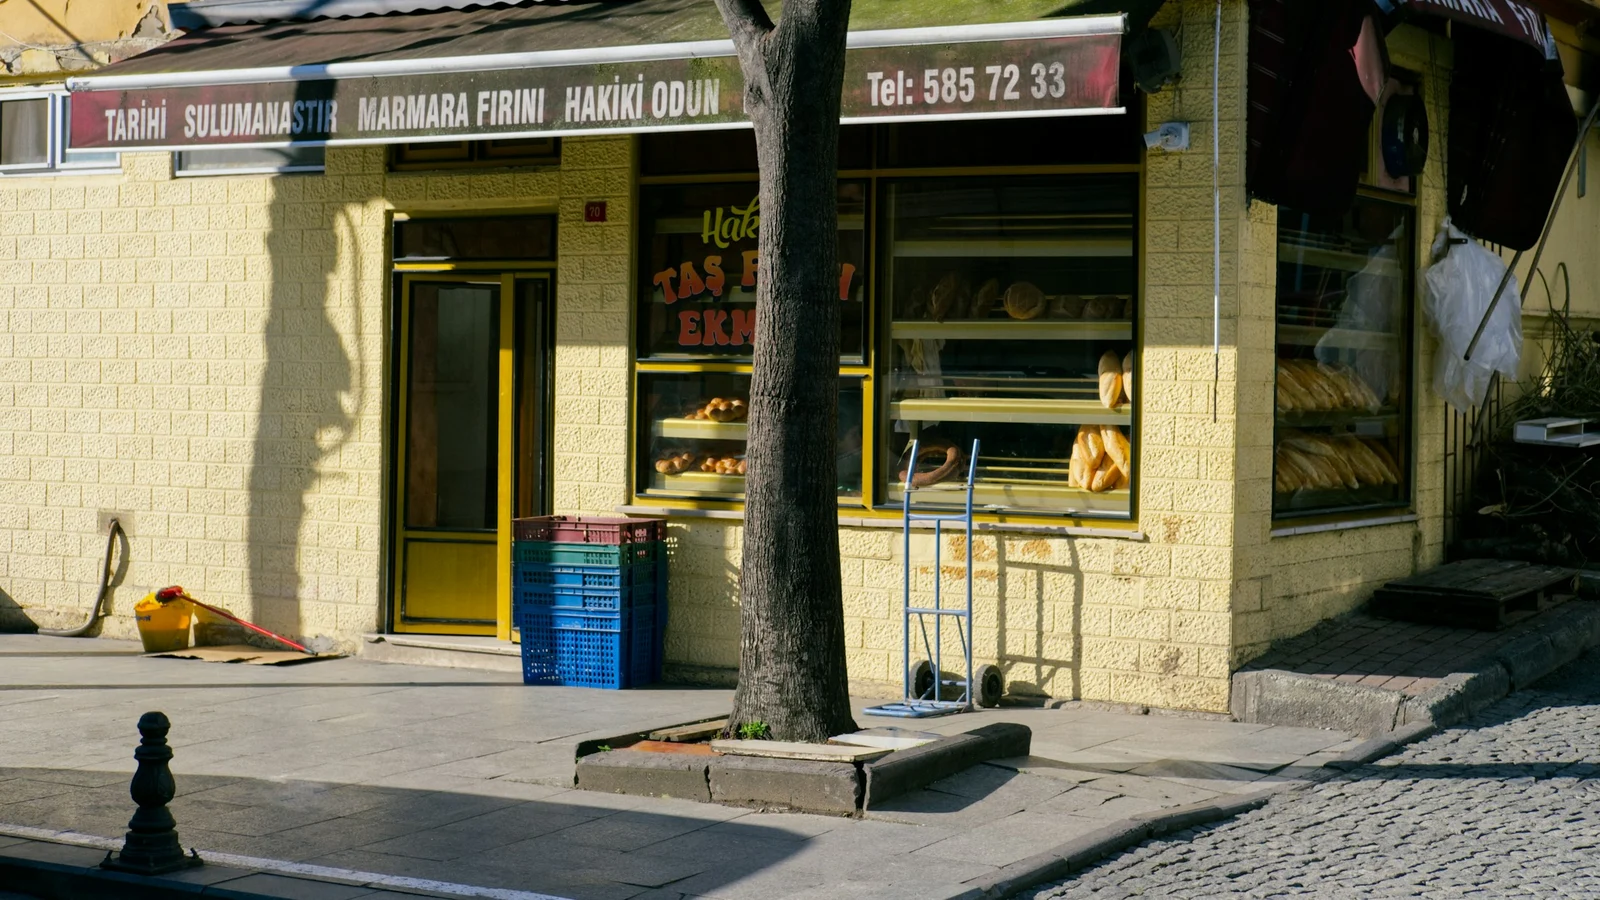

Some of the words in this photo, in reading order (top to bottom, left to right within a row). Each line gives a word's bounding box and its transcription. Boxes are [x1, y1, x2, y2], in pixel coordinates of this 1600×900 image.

[105, 99, 166, 141] TARİHİ
[184, 100, 338, 138] SULUMANASTIR
[358, 92, 469, 131] MARMARA
[476, 88, 545, 126] FIRINI
[565, 74, 643, 122] HAKİKİ
[652, 79, 720, 119] ODUN
[867, 71, 913, 106] Tel:
[924, 67, 975, 104] 585
[986, 64, 1020, 100] 72
[1030, 62, 1066, 99] 33
[590, 206, 600, 218] 70
[653, 255, 725, 305] TAŞ
